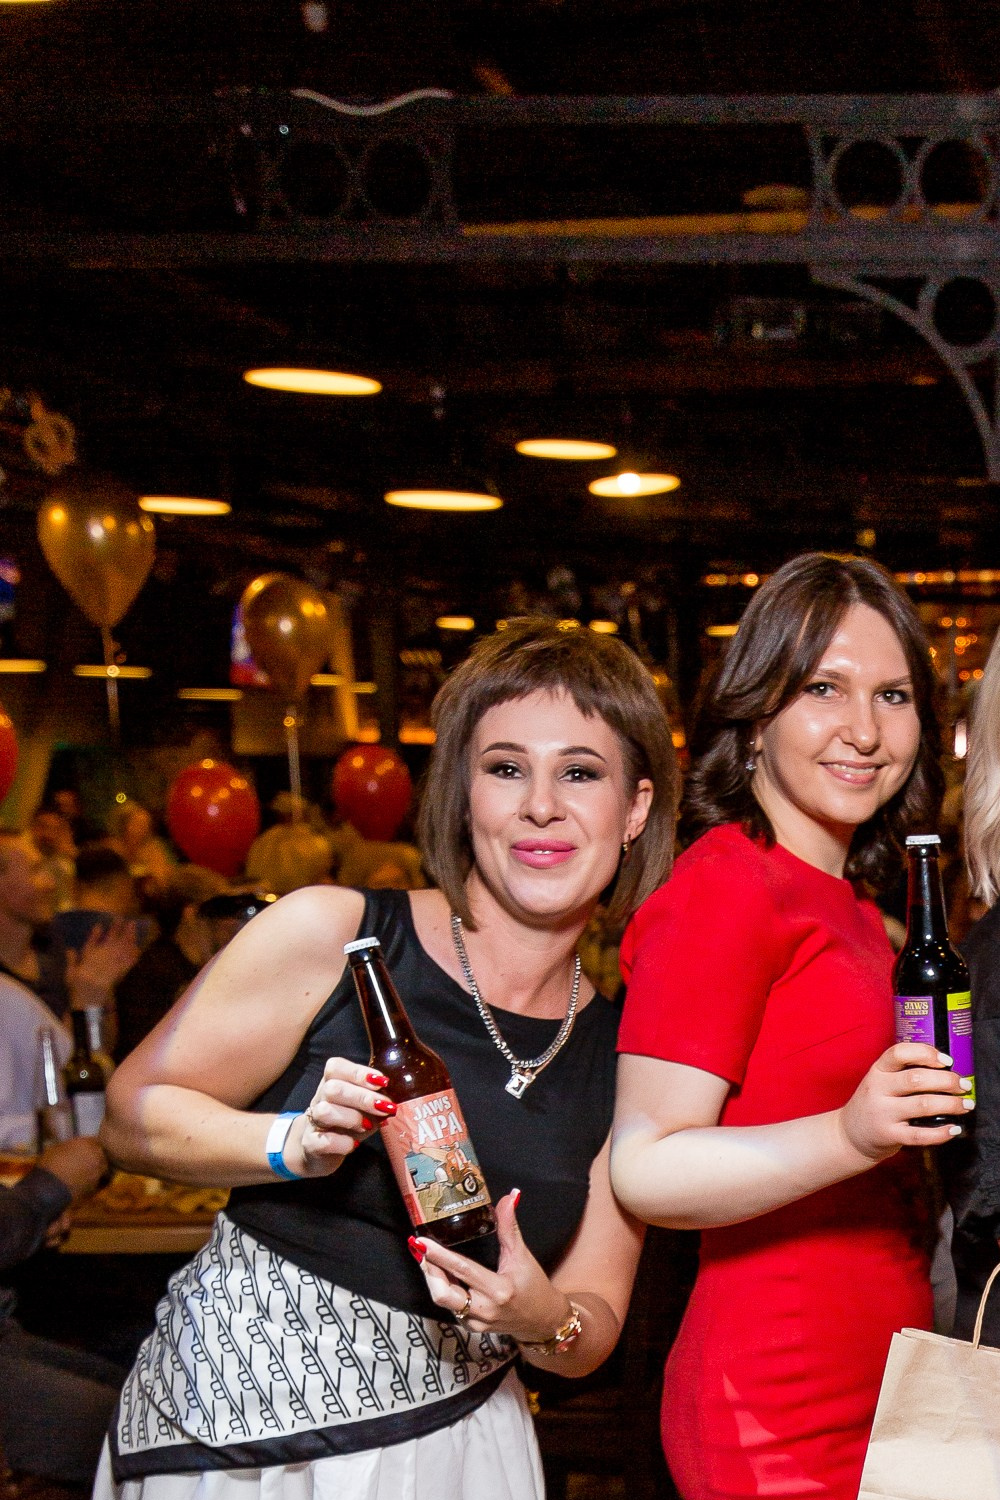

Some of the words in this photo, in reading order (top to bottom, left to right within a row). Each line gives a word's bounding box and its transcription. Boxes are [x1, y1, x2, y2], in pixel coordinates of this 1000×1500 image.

[904, 1001, 929, 1010] JAWS
[413, 1095, 452, 1121] JAWS
[417, 1111, 463, 1145] APA
